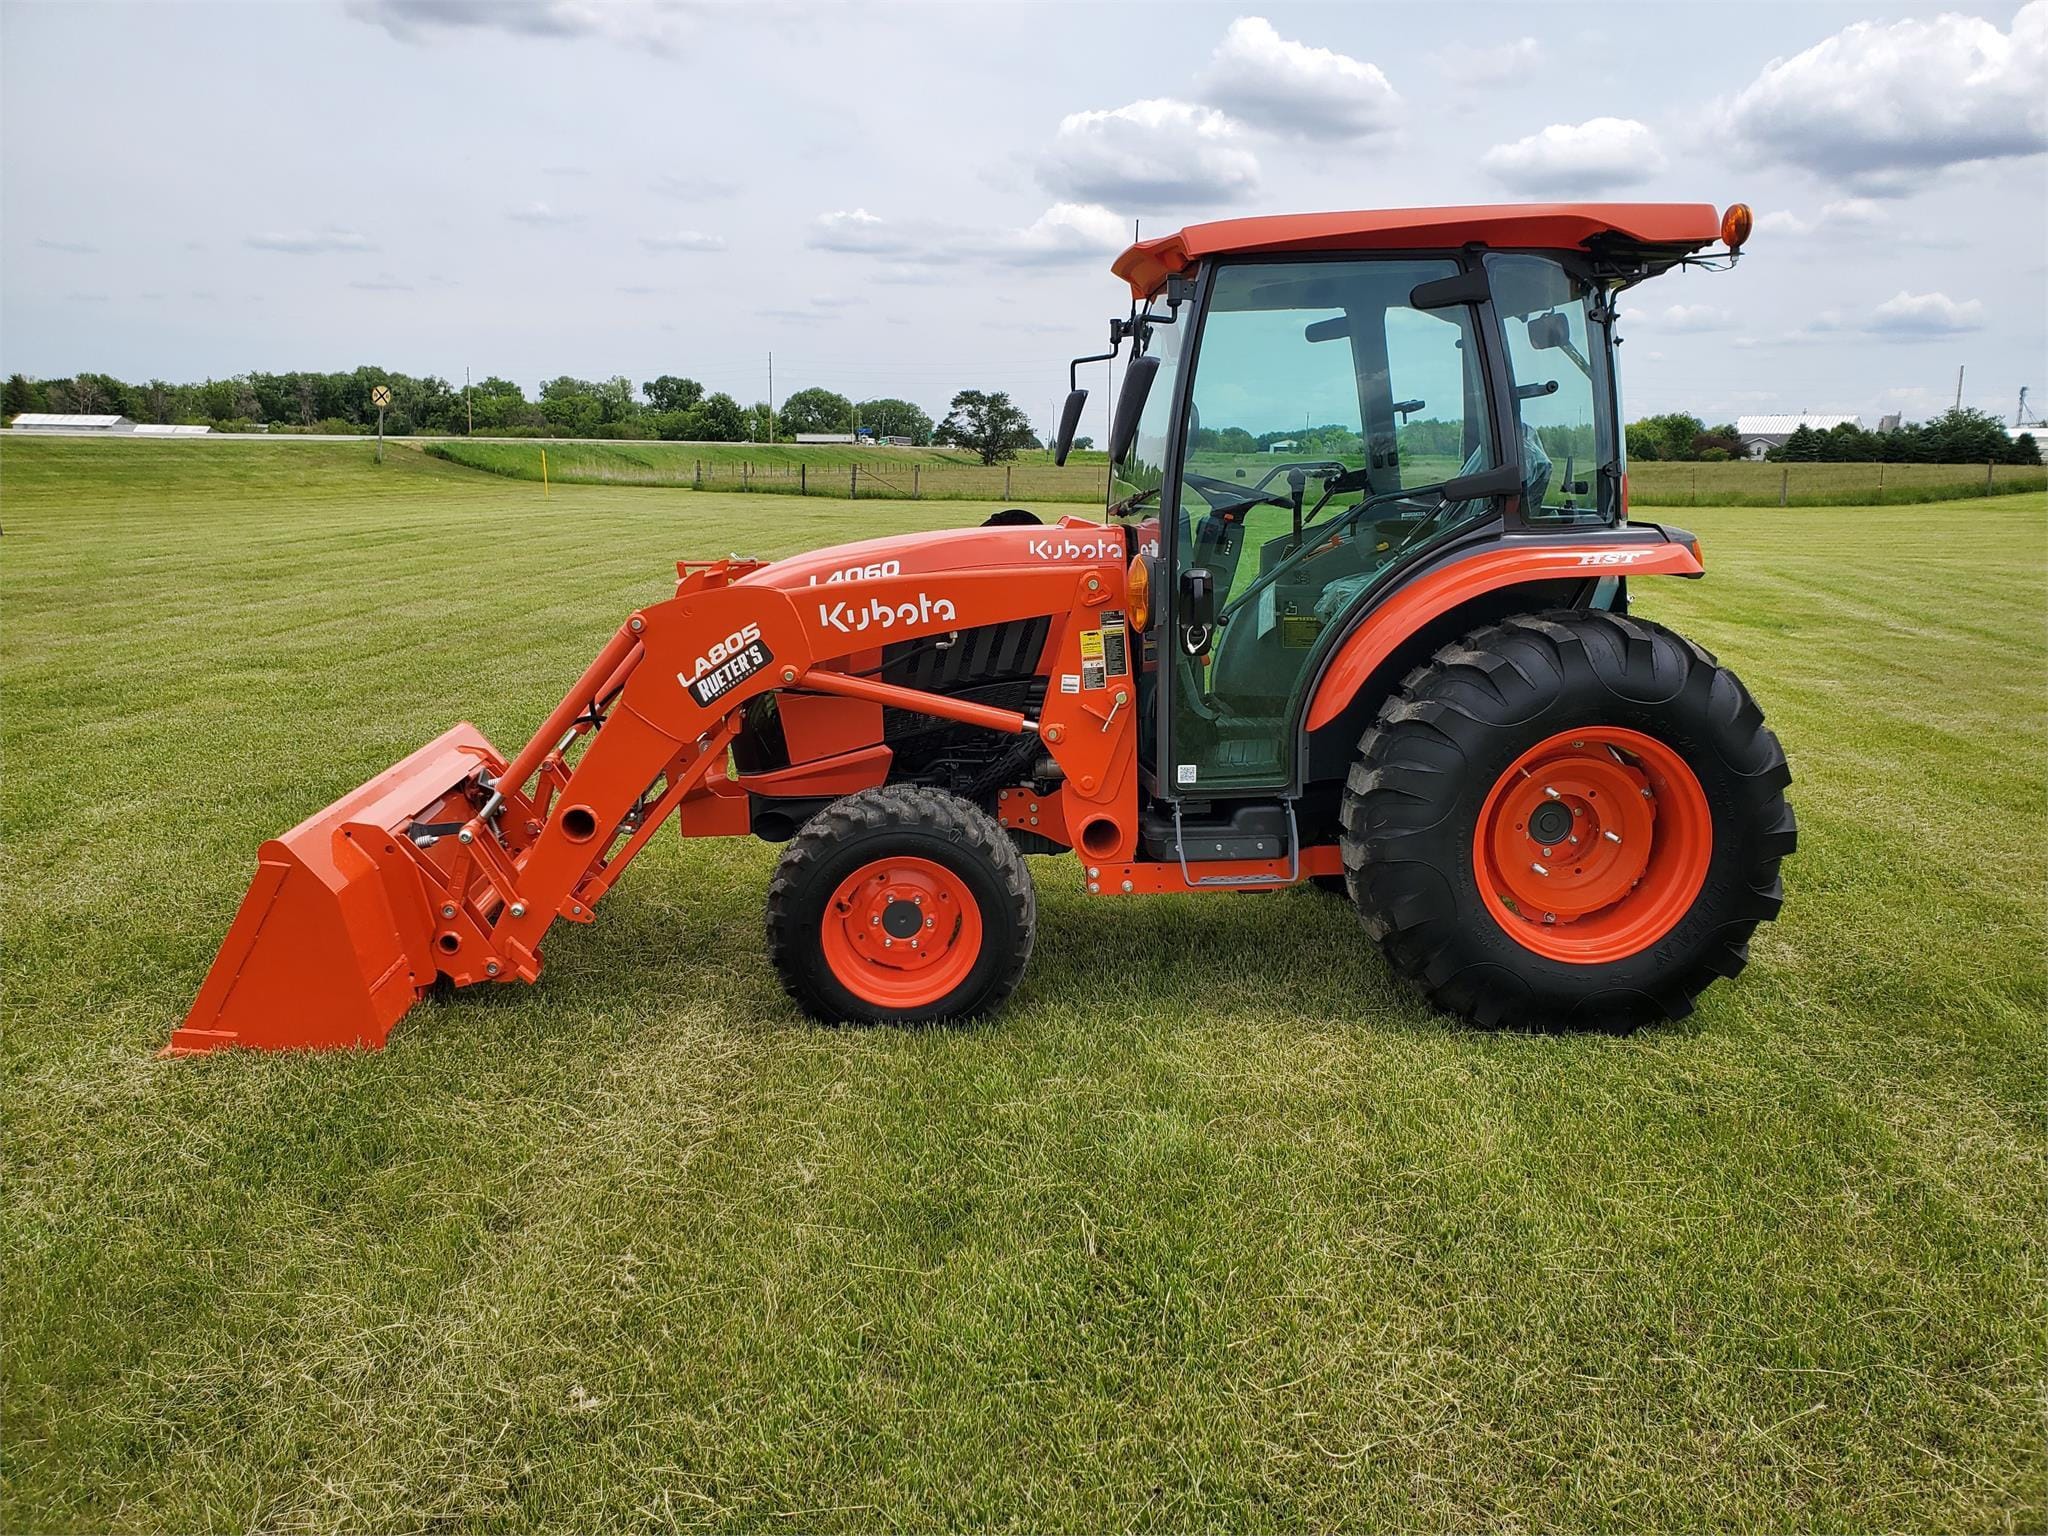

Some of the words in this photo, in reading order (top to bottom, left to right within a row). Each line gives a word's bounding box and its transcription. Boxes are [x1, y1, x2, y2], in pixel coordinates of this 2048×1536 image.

[1029, 538, 1122, 559] Kubota
[1577, 552, 1641, 566] HST
[809, 560, 900, 586] L4060
[819, 592, 956, 632] Kubota
[676, 621, 761, 688] LA805
[696, 644, 763, 702] RUETER'S
